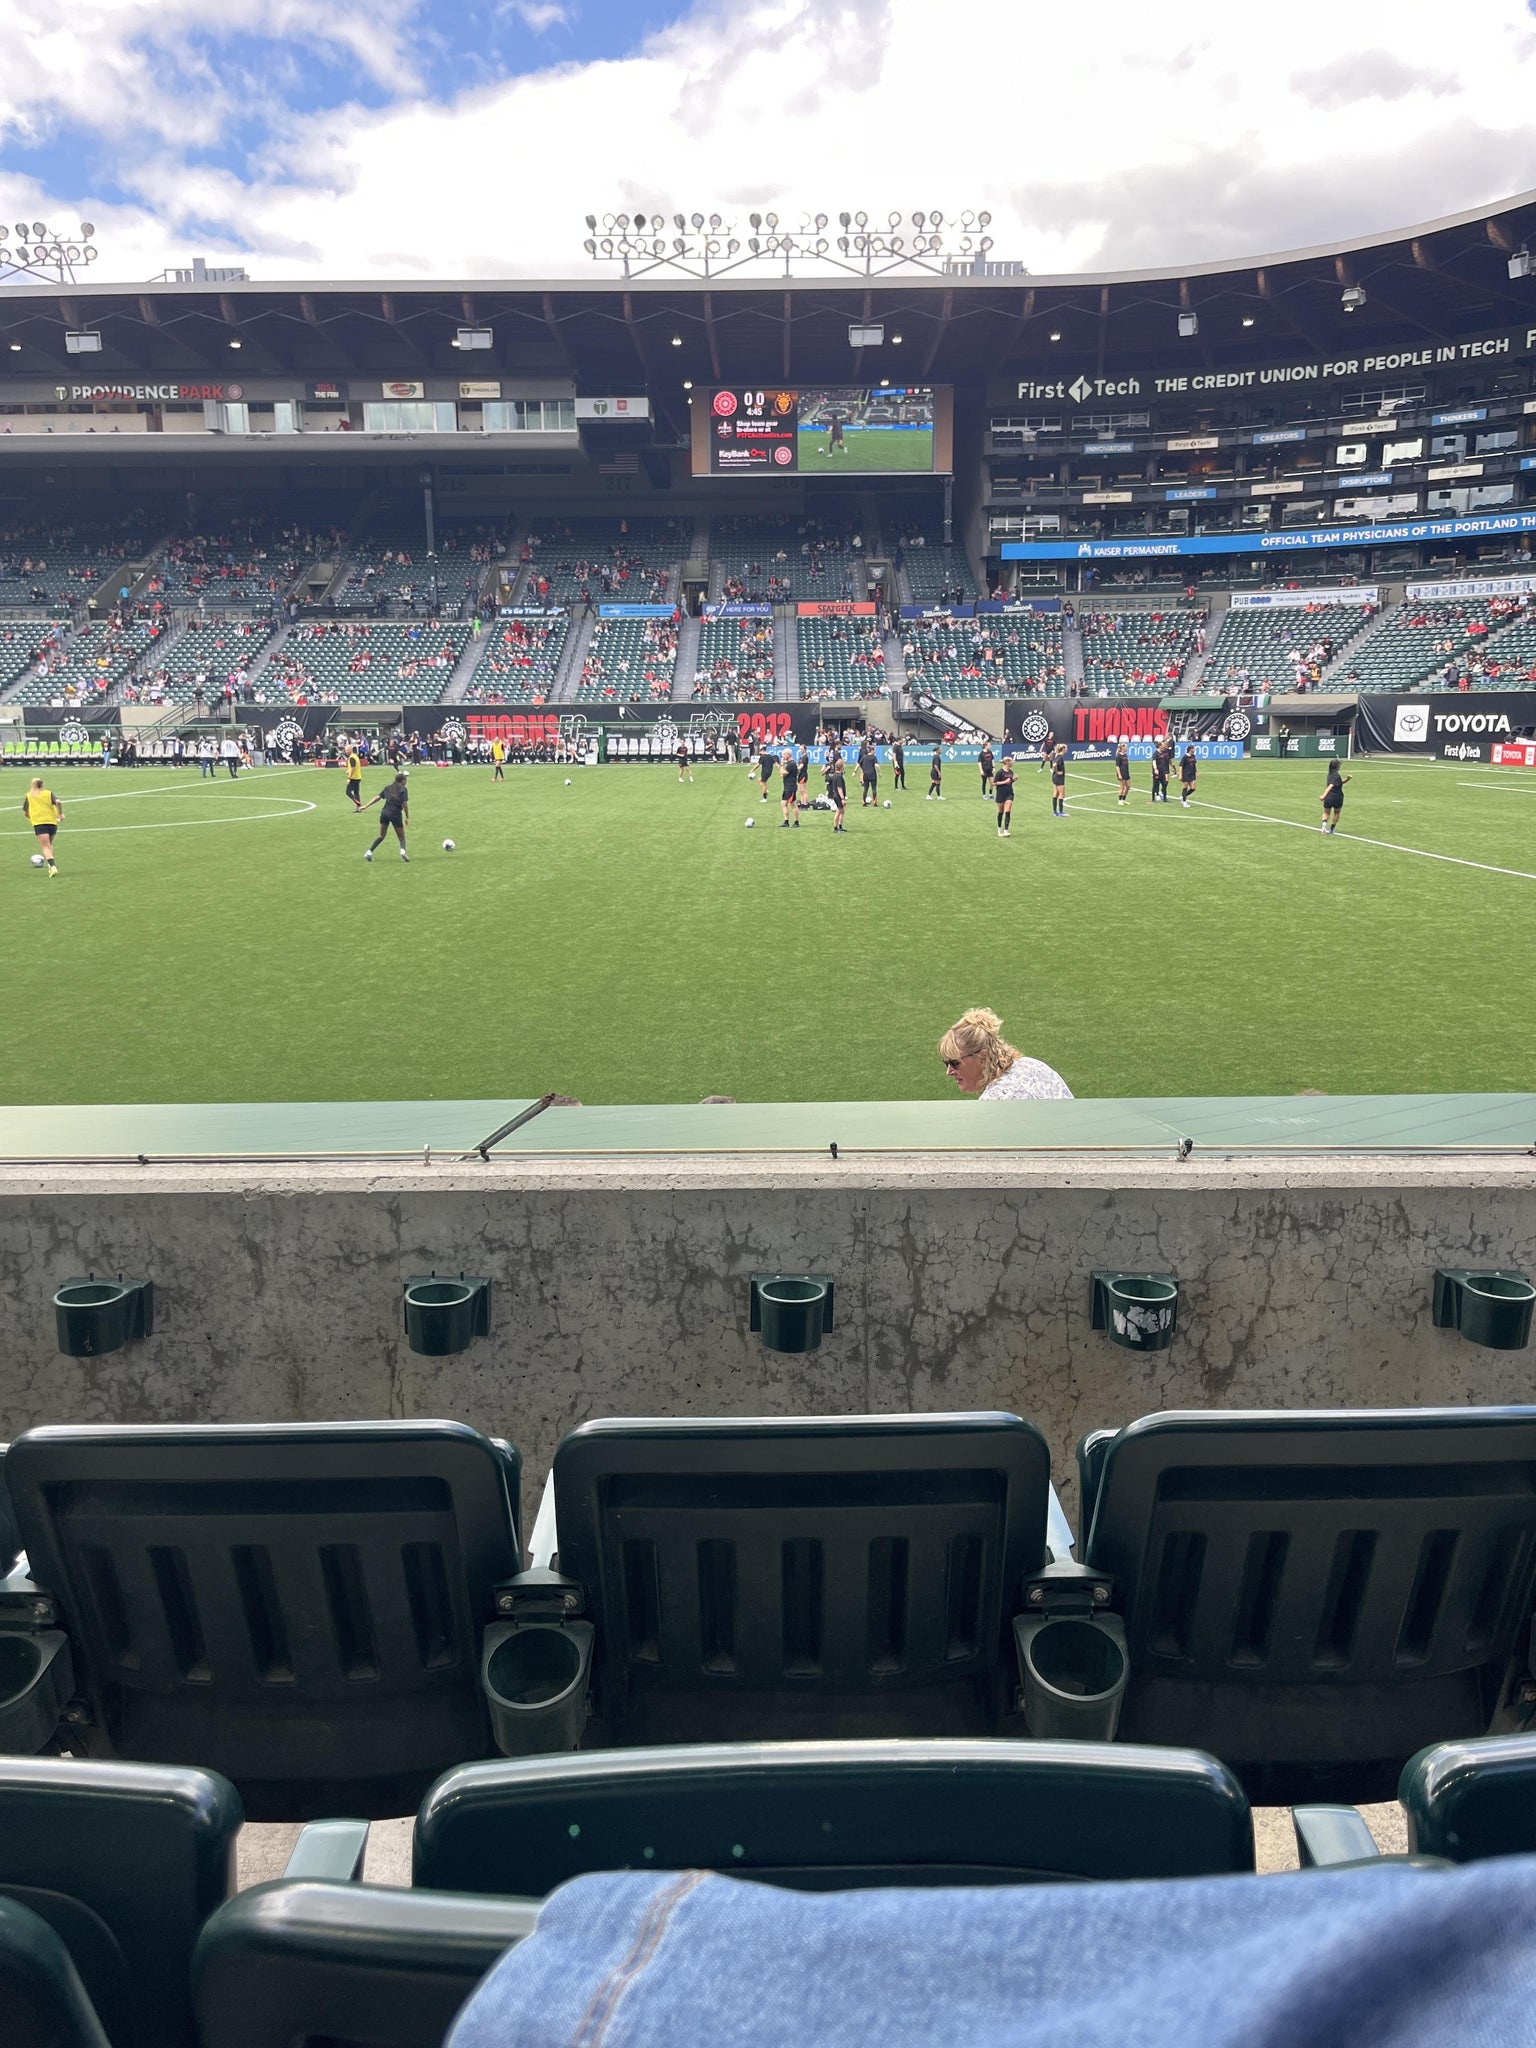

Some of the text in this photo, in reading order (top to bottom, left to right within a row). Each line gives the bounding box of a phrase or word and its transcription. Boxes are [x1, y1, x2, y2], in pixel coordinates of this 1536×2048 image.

[1155, 338, 1510, 393] THE CREDIT UNION FOR PEOPLE IN TECH
[1018, 377, 1140, 400] First Tech
[744, 392, 765, 406] 0 0
[746, 408, 763, 416] 4:45
[1440, 412, 1478, 423] THINKERS
[1260, 432, 1300, 442] CREATORS
[718, 450, 750, 459] KeyBank
[1342, 476, 1390, 486] DISRUPTORS
[1174, 490, 1208, 498] LEADERS
[1261, 536, 1308, 547] OFFICIAL
[1310, 532, 1340, 544] TEAM
[1342, 528, 1409, 542] PHYSICIANS
[1412, 526, 1428, 536] OF
[1430, 524, 1452, 534] THE
[1454, 518, 1518, 532] PORTLAND
[1094, 544, 1180, 556] KAISER PERMANENTE
[524, 606, 545, 614] Time!
[818, 604, 856, 613] SEATGEEK
[466, 714, 558, 745] THORNS
[737, 712, 792, 745] 2012
[1074, 708, 1168, 742] THORNS
[1434, 714, 1511, 733] TOYOTA
[1072, 748, 1112, 760] Tillamook
[1128, 744, 1152, 759] ring
[1214, 744, 1238, 759] ring
[1444, 743, 1481, 758] First Tech
[1503, 750, 1522, 760] TOYOTA
